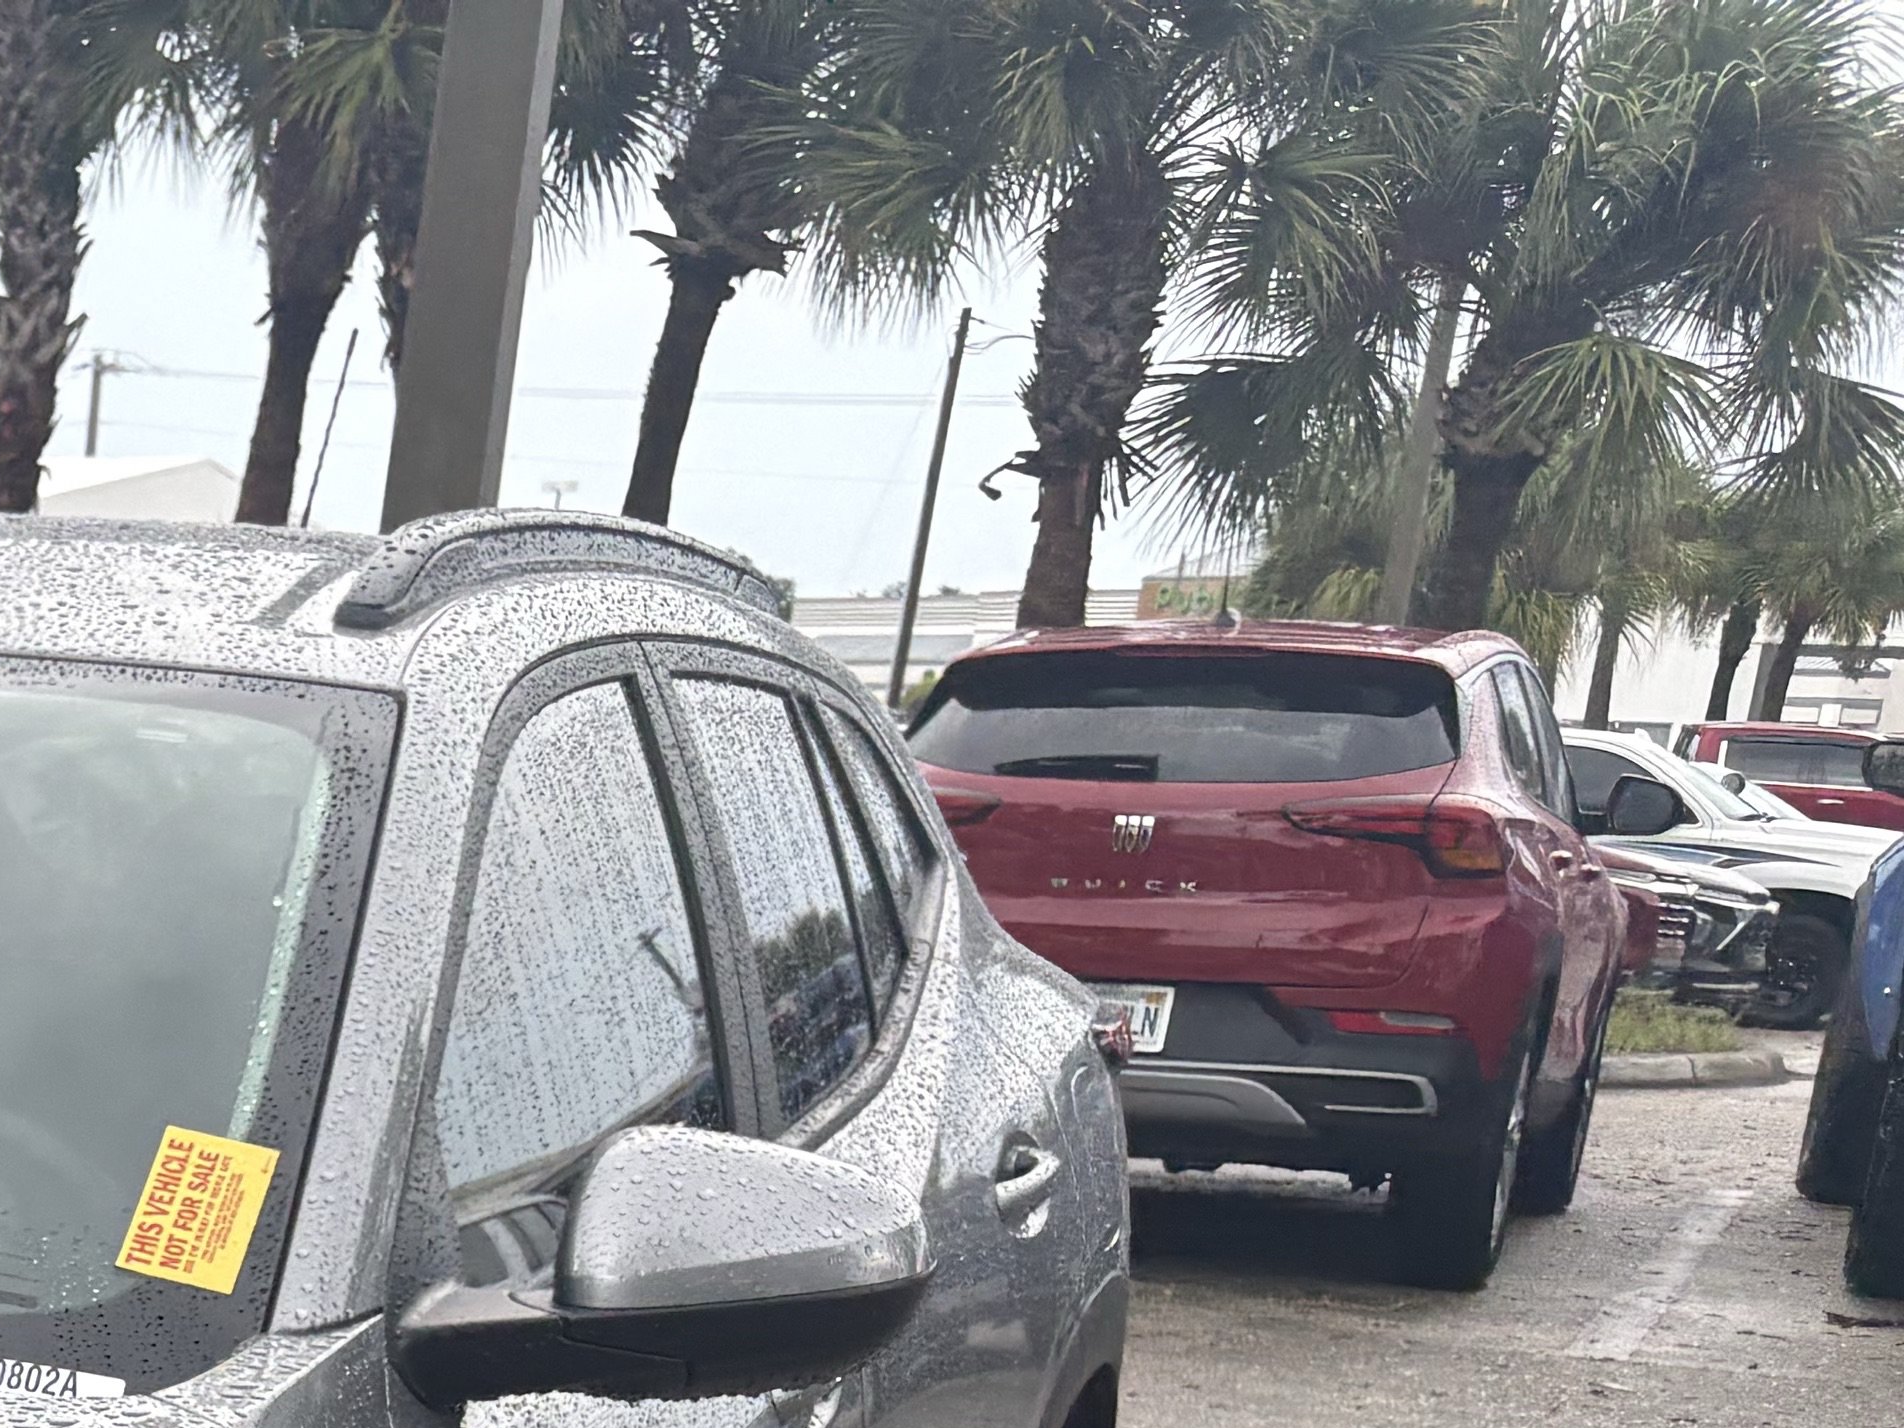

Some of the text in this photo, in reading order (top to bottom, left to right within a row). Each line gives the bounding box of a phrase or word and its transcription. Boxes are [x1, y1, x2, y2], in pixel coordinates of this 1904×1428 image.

[185, 1149, 220, 1194] SALE
[124, 1137, 195, 1268] THIS VEHICLE
[171, 1194, 203, 1232] FOR
[157, 1233, 189, 1270] NOT
